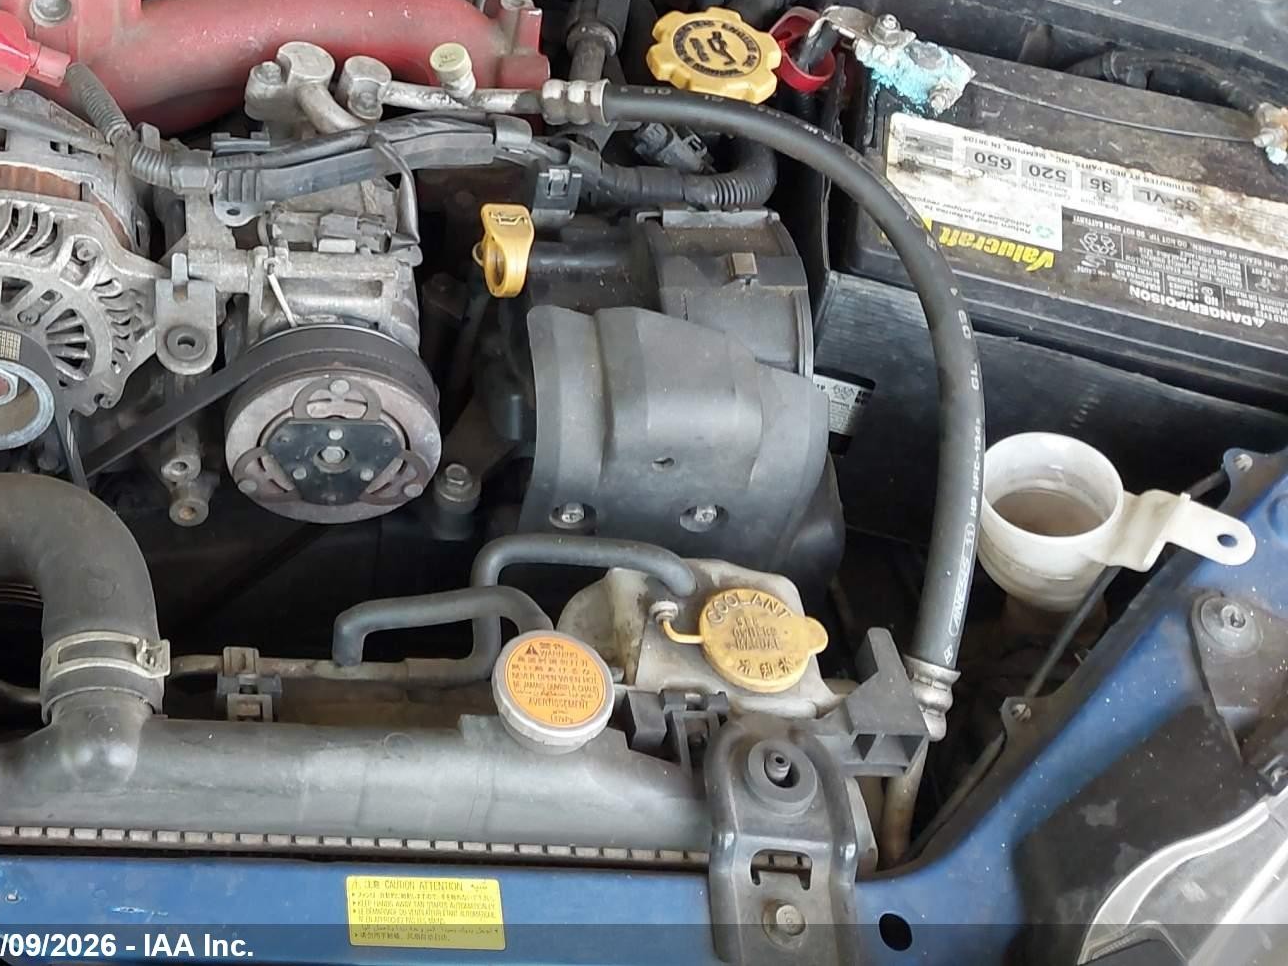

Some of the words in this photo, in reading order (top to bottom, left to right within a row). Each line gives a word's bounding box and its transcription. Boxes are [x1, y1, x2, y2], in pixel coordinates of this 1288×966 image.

[973, 150, 1012, 170] 650
[1027, 163, 1067, 182] 520
[939, 226, 1055, 272] Valucraft
[1128, 285, 1253, 326] DANGER/POISON
[706, 593, 793, 622] COOLANT
[385, 880, 415, 890] CAUTION
[420, 880, 463, 891] ATTENTION
